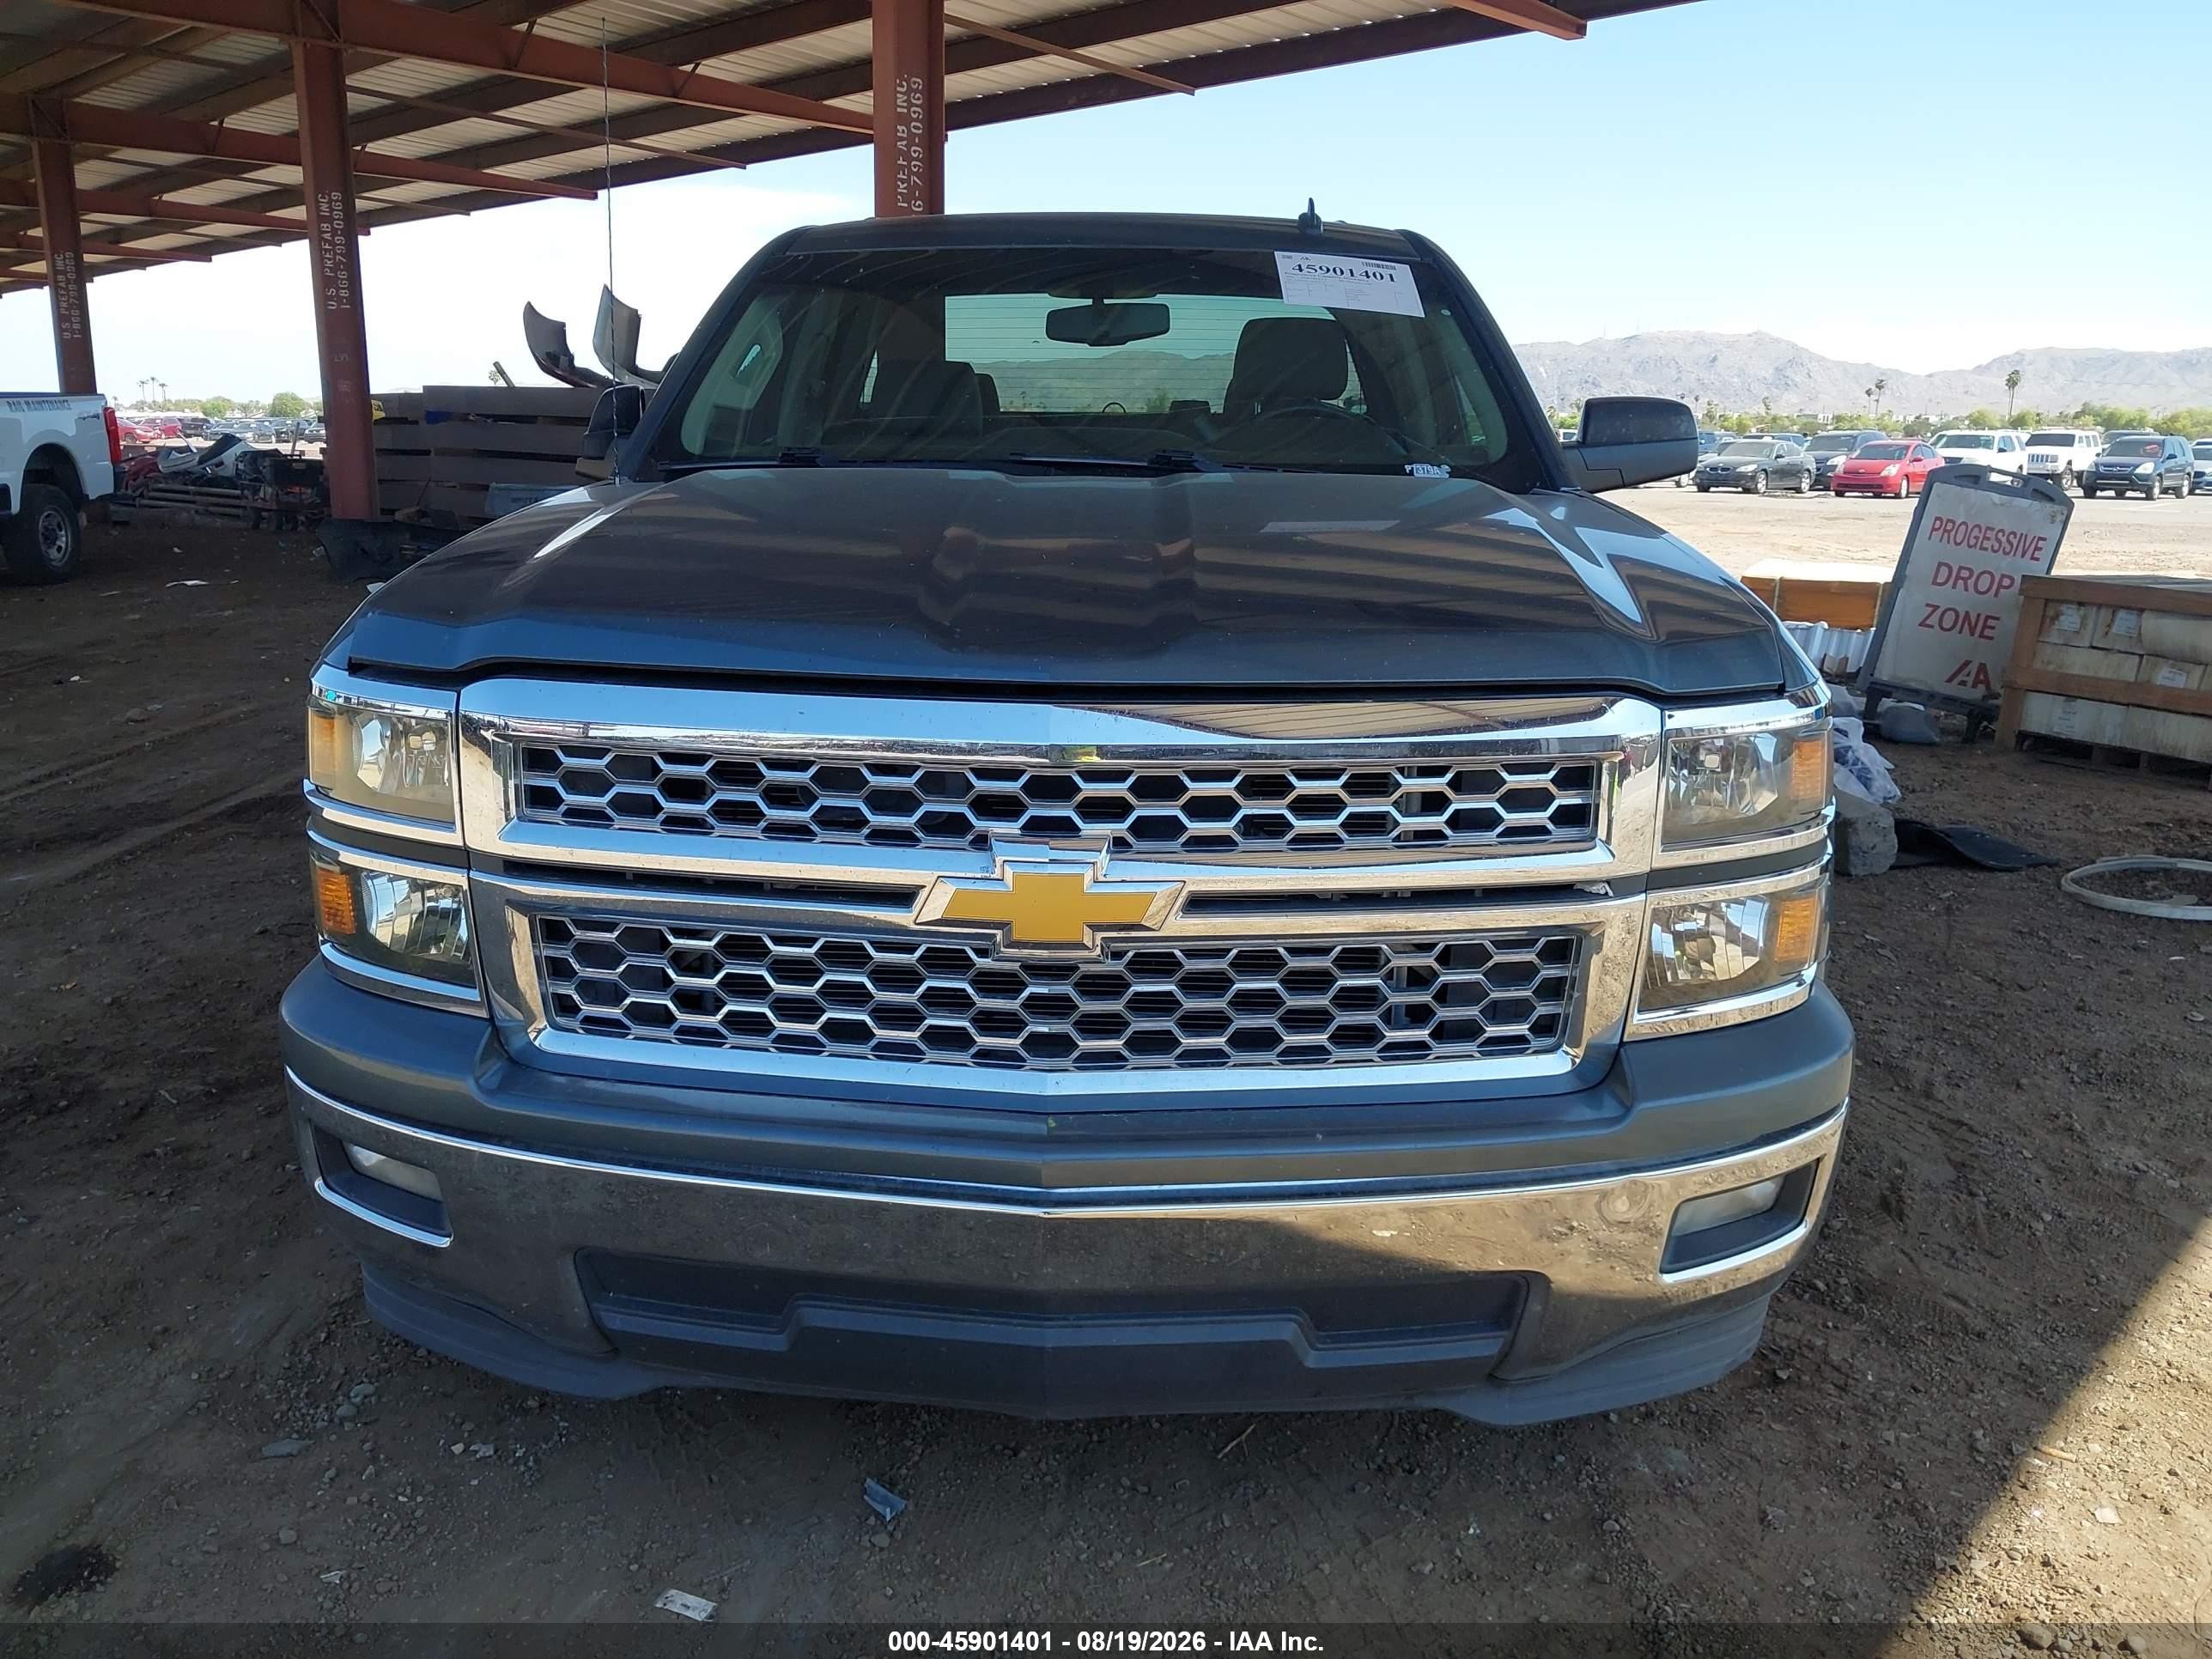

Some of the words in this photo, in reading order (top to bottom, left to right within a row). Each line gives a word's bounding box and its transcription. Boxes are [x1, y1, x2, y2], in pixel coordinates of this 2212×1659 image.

[896, 74, 908, 113] INC.
[896, 125, 908, 208] PREFAB
[910, 77, 924, 215] 6-799-0969
[320, 223, 335, 276] PREFAB
[331, 191, 350, 308] 1-866-799-0969
[57, 275, 69, 314] PREFAB
[1291, 263, 1397, 283] 45901401
[1928, 515, 2048, 562] PROGESSIVE
[1930, 561, 2015, 599] DROP
[1917, 603, 2001, 641] ZONE
